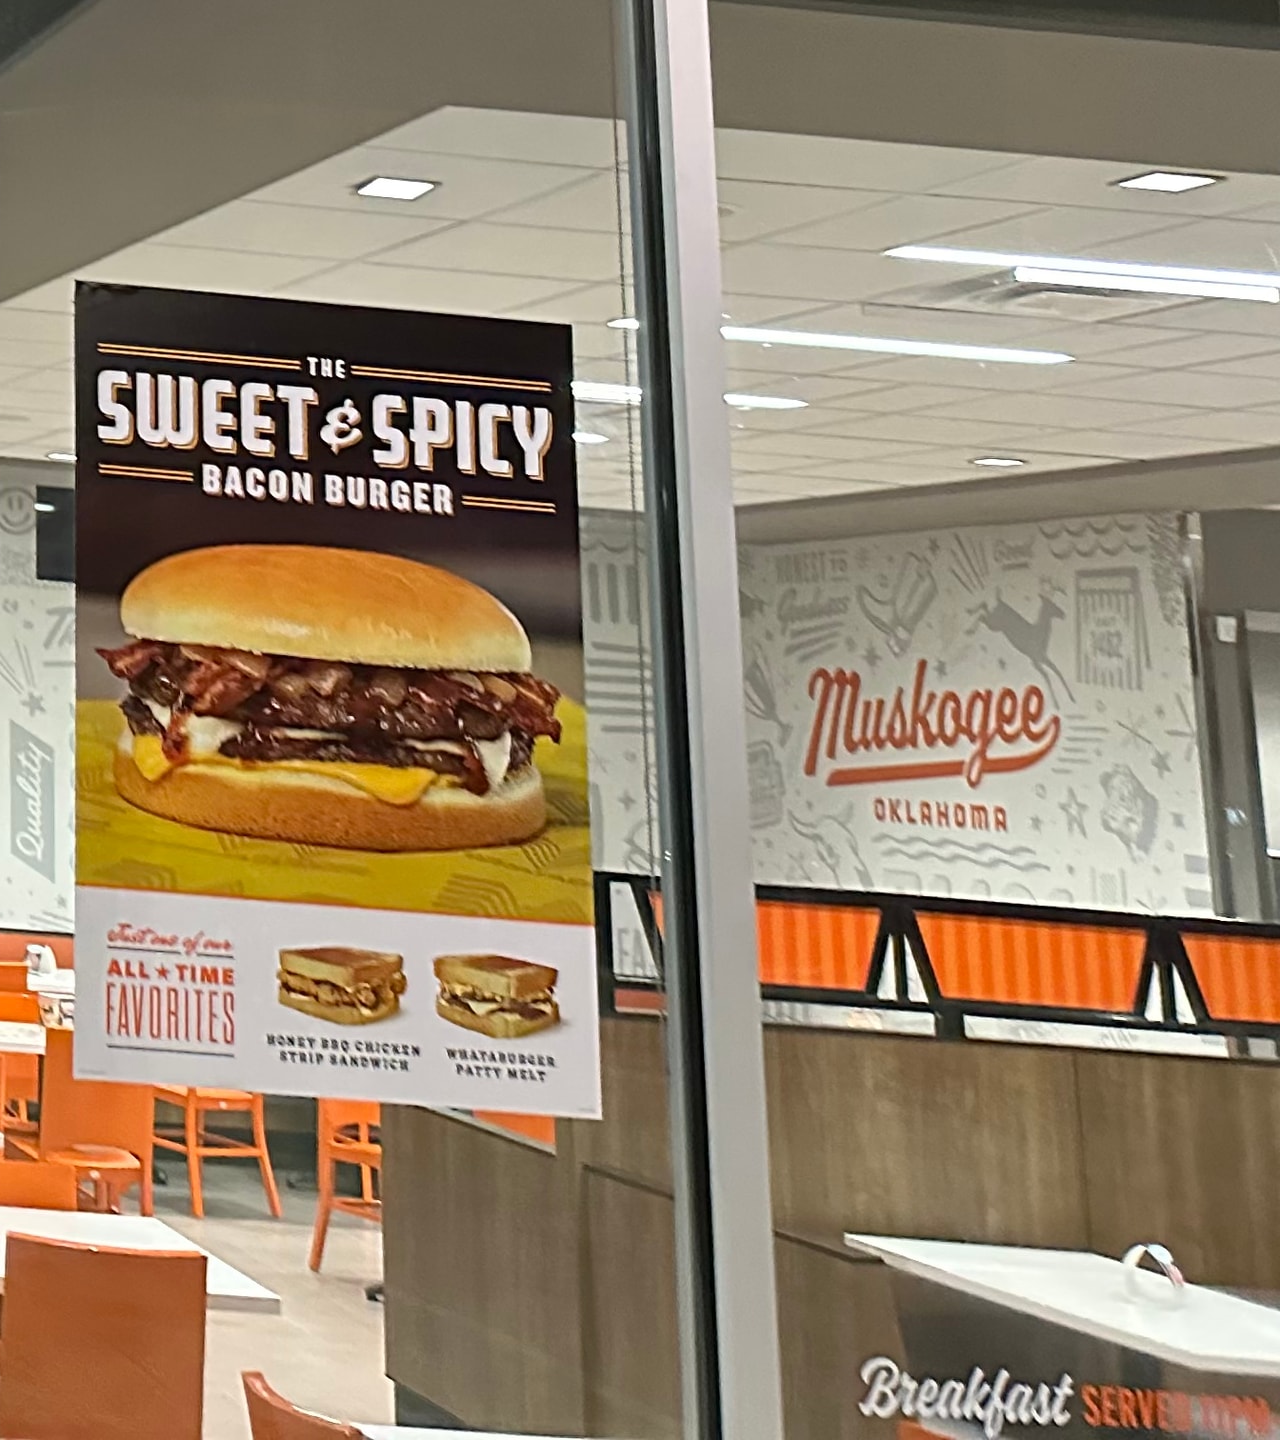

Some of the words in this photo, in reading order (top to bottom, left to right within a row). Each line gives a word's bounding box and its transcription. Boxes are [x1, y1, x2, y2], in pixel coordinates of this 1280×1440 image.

[307, 357, 347, 379] THE
[97, 369, 319, 460] SWEET
[319, 399, 363, 455] &
[371, 392, 553, 482] SPICY
[201, 463, 315, 505] BACON
[324, 477, 455, 516] BURGER
[804, 658, 1061, 789] Muskogee
[16, 741, 52, 861] Quality
[873, 797, 1008, 832] OKLAHOMA
[107, 958, 150, 980] ALL
[175, 963, 235, 986] TIME
[106, 981, 235, 1045] FAVORITES
[266, 1033, 316, 1049] HONEY
[320, 1037, 350, 1053] BBQ
[354, 1040, 421, 1057] CHICKEN
[279, 1050, 324, 1065] STRIP
[328, 1053, 410, 1072] SANDWICH
[445, 1047, 557, 1068] WHATABURGER
[455, 1063, 501, 1079] PATTY
[507, 1068, 547, 1083] MELT
[858, 1356, 1076, 1440] Breakfast
